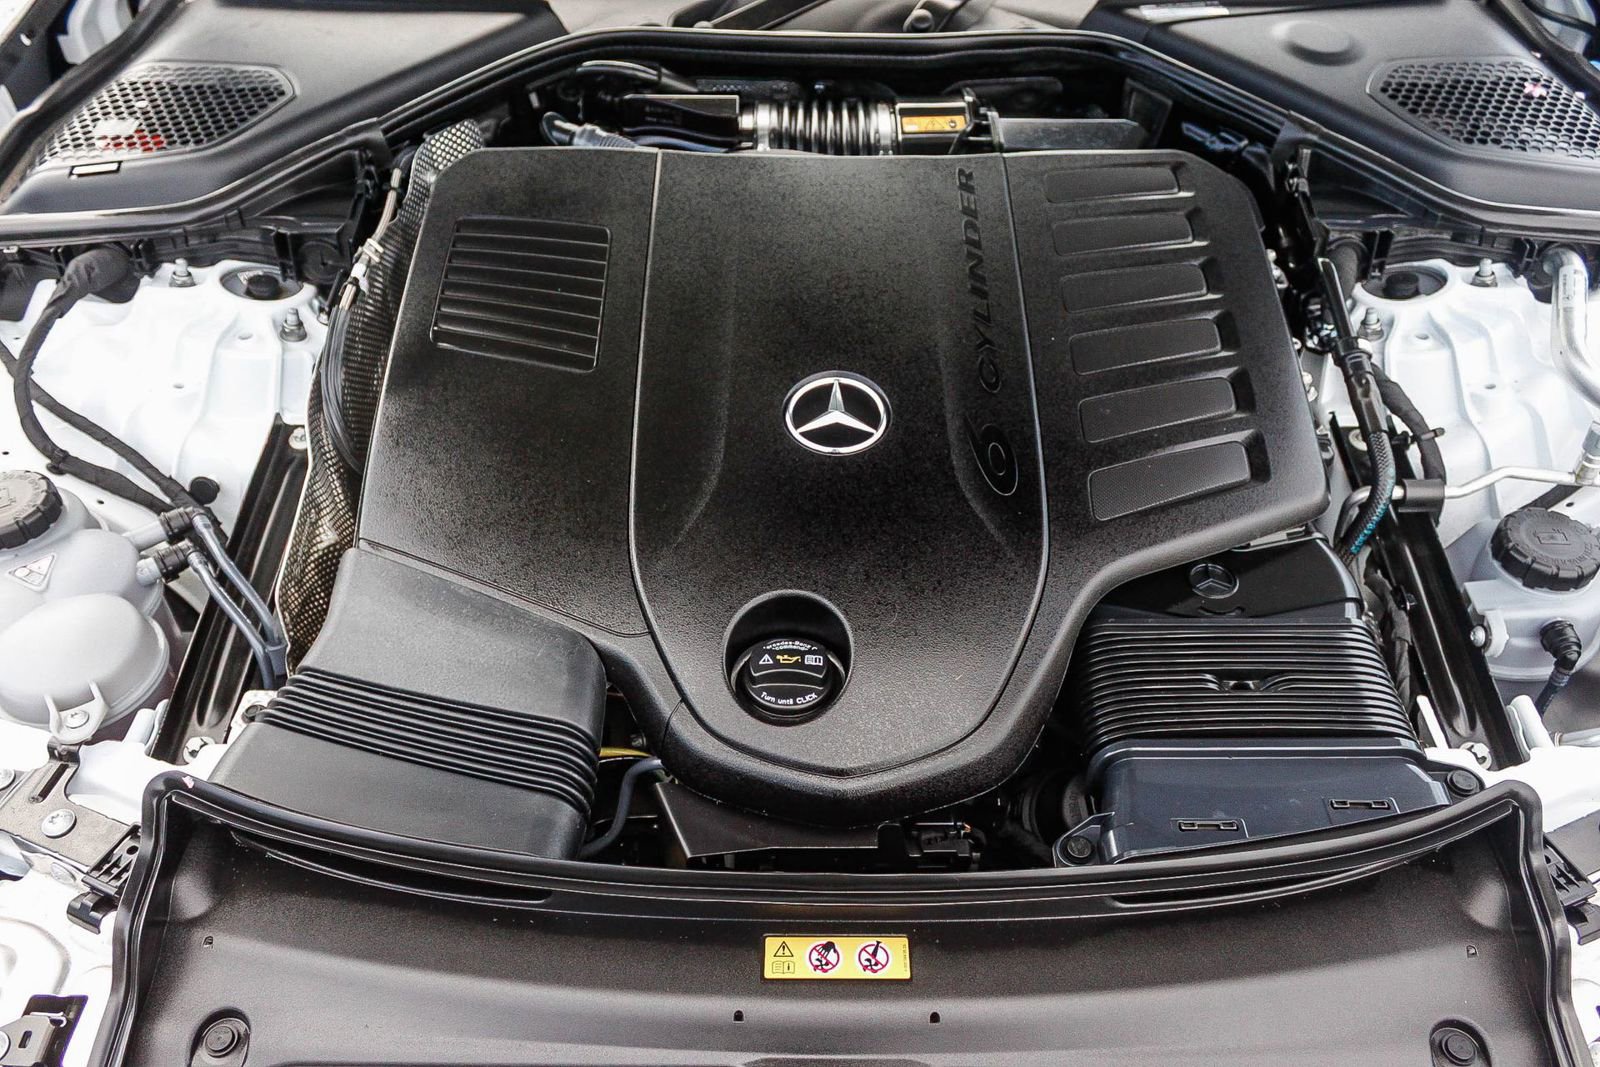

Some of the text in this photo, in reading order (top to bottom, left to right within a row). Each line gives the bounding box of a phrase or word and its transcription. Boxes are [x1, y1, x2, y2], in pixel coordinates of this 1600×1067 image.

[956, 166, 1019, 496] 6 CYLINDER
[762, 640, 812, 649] ercedes-Benz
[760, 691, 776, 703] Turn
[796, 692, 818, 704] CLICK
